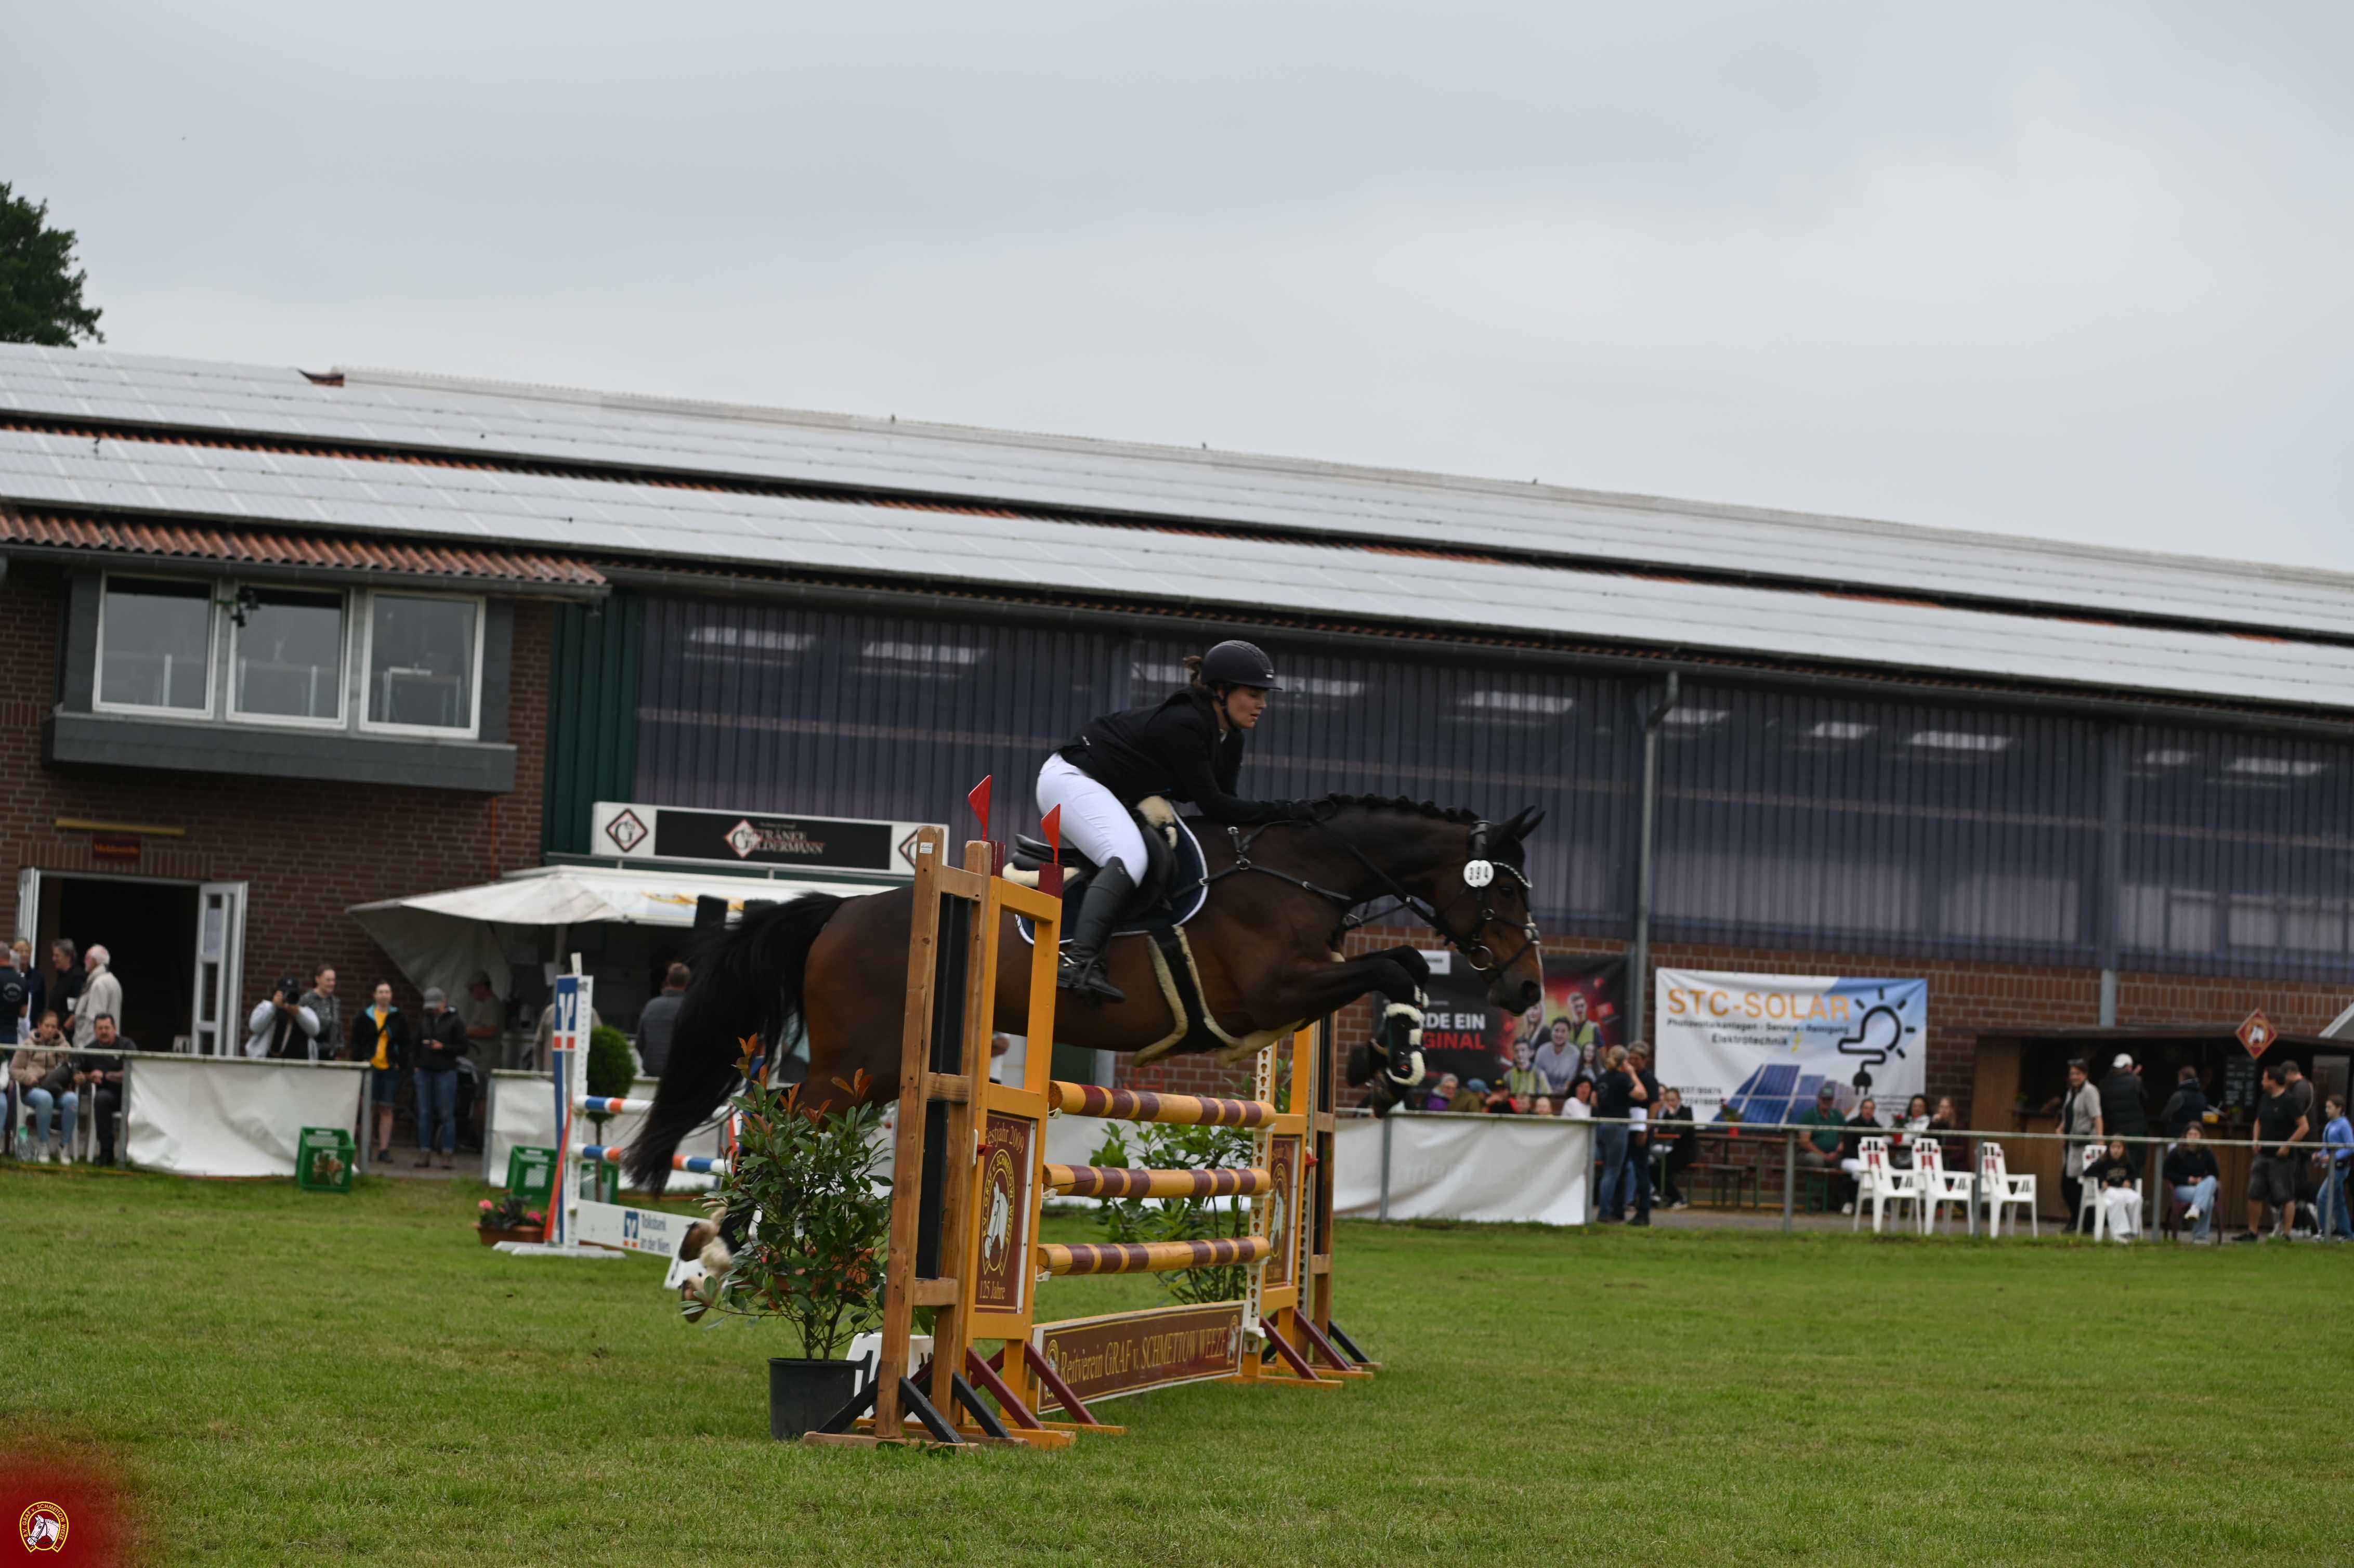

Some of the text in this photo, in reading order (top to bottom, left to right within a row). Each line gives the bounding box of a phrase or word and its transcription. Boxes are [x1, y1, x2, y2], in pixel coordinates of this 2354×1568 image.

[1667, 987, 1850, 1021] STC-SOLAR
[1455, 1014, 1486, 1030] EIN
[1423, 1031, 1486, 1050] GINAL
[1712, 1033, 1788, 1046] Elektrotechnik
[986, 1122, 1024, 1154] estjahr 2009
[980, 1280, 1006, 1300] 125 Jahre
[1061, 1326, 1227, 1385] Reitverein GRAF v. SCHMETTOW WEEZE
